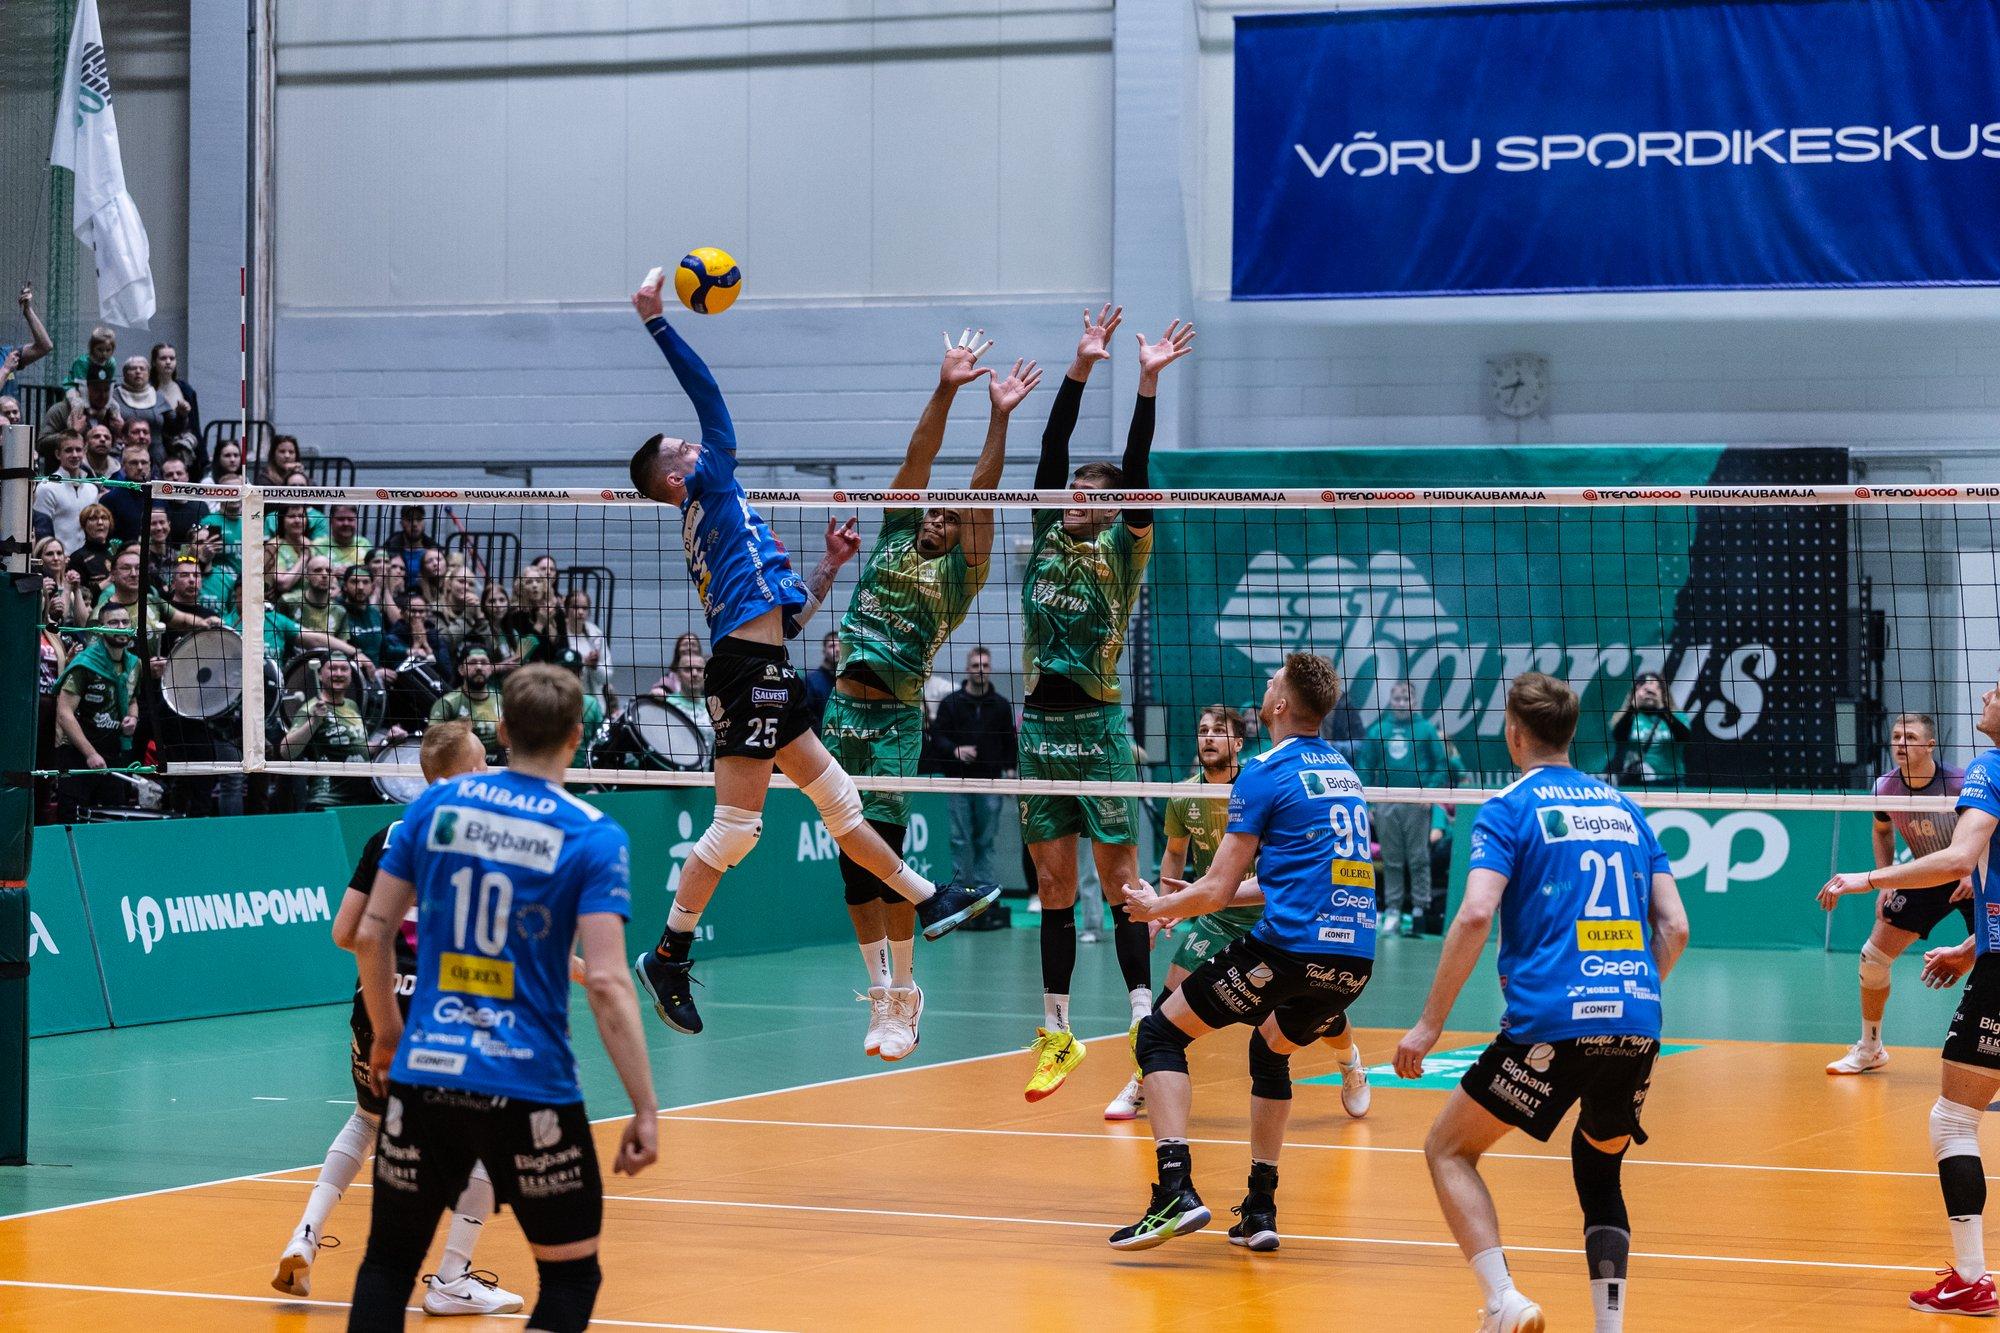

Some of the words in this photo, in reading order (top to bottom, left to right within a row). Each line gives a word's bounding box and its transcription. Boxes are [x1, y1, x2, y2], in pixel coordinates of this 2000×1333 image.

[1294, 131, 1481, 178] VÕRU
[263, 489, 346, 498] DUKAUBAMAJA
[465, 490, 570, 499] PUIDUKAUBAMAJA
[927, 492, 1040, 501] PUIDUKAUBAMAJA
[1171, 492, 1286, 501] PUIDUKAUBAMAJA
[1423, 491, 1546, 500] PUIDUKAUBAMAJA
[1690, 489, 1817, 499] PUIDUKAUBAMAJA
[754, 690, 786, 701] SALVEST
[745, 717, 779, 749] 25
[1301, 752, 1347, 765] NAABE
[456, 778, 558, 815] KAIBALD
[1325, 777, 1364, 792] Bigba
[1533, 785, 1622, 803] WILLIAMS
[1329, 803, 1371, 860] 99
[1571, 814, 1635, 834] Bigbank
[464, 820, 555, 860] Bigbank
[1646, 809, 1790, 893] op
[1340, 867, 1371, 880] OLEREX
[1579, 849, 1631, 918] 21
[165, 886, 331, 934] HINNAPOMM
[450, 866, 514, 956] 10
[1183, 932, 1211, 958] 14
[1587, 929, 1634, 942] OLEREX
[1226, 966, 1263, 1006] Bigbank
[1309, 980, 1350, 995] CATERING
[1585, 1046, 1638, 1058] CATERING
[1493, 1073, 1542, 1110] SEKURIT
[1501, 1056, 1554, 1098] Bigbank
[514, 1146, 583, 1173] Bigbank
